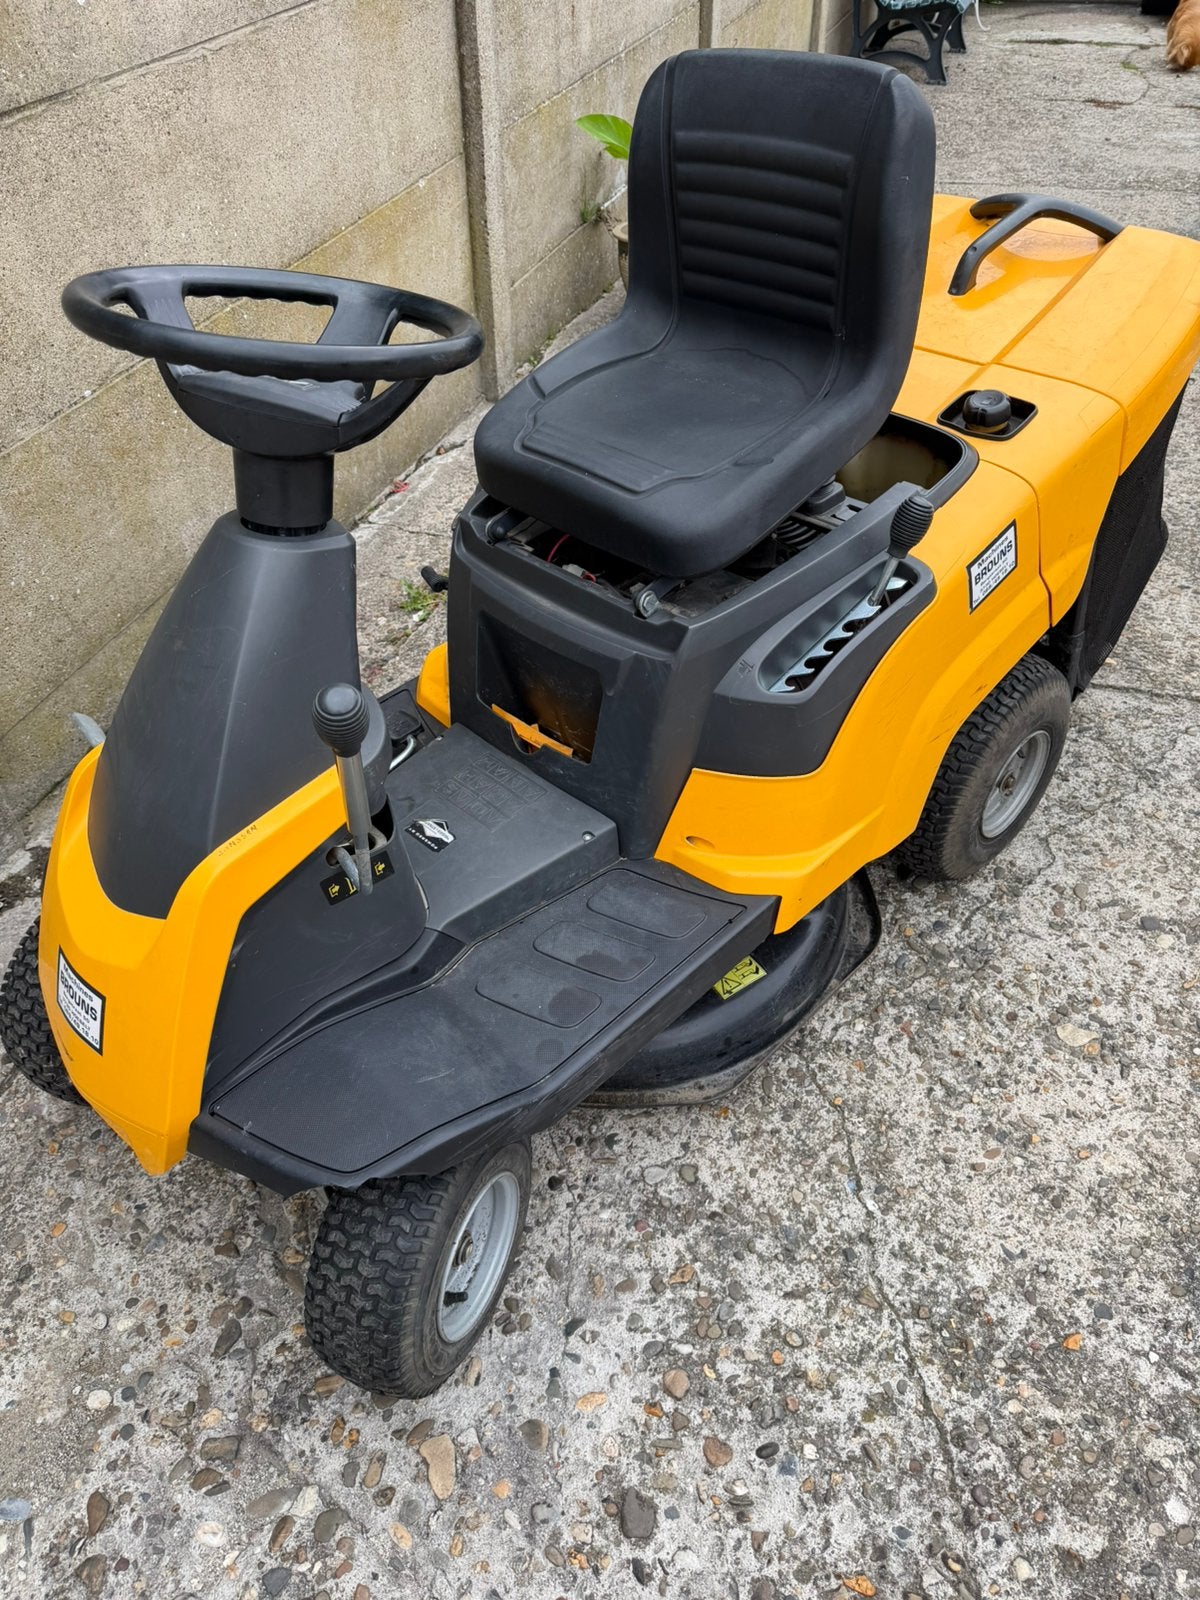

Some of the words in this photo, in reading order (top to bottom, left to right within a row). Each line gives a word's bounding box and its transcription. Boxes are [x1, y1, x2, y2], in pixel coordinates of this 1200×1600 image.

[974, 540, 1013, 586] BROUNS
[60, 970, 98, 1022] BROUNS
[63, 963, 94, 1002] Machines
